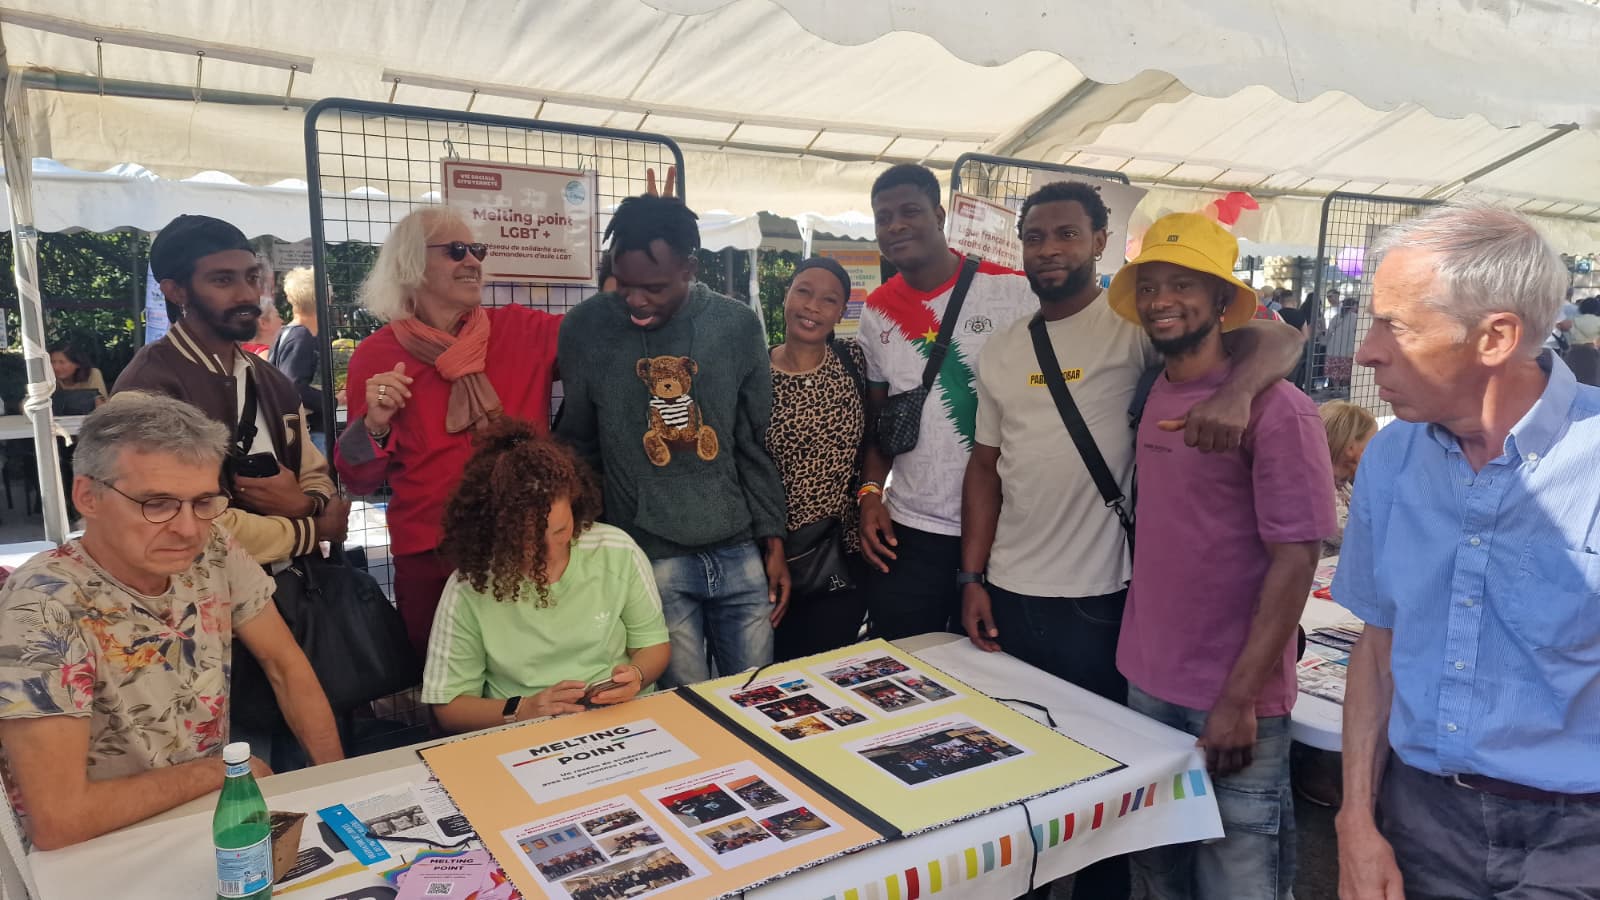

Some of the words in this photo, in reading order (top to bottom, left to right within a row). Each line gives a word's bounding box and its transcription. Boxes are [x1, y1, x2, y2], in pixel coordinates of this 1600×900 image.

[472, 207, 533, 226] Melting
[537, 212, 573, 227] point
[500, 226, 540, 240] LGBT
[529, 727, 630, 757] MELTING
[557, 742, 626, 765] POINT
